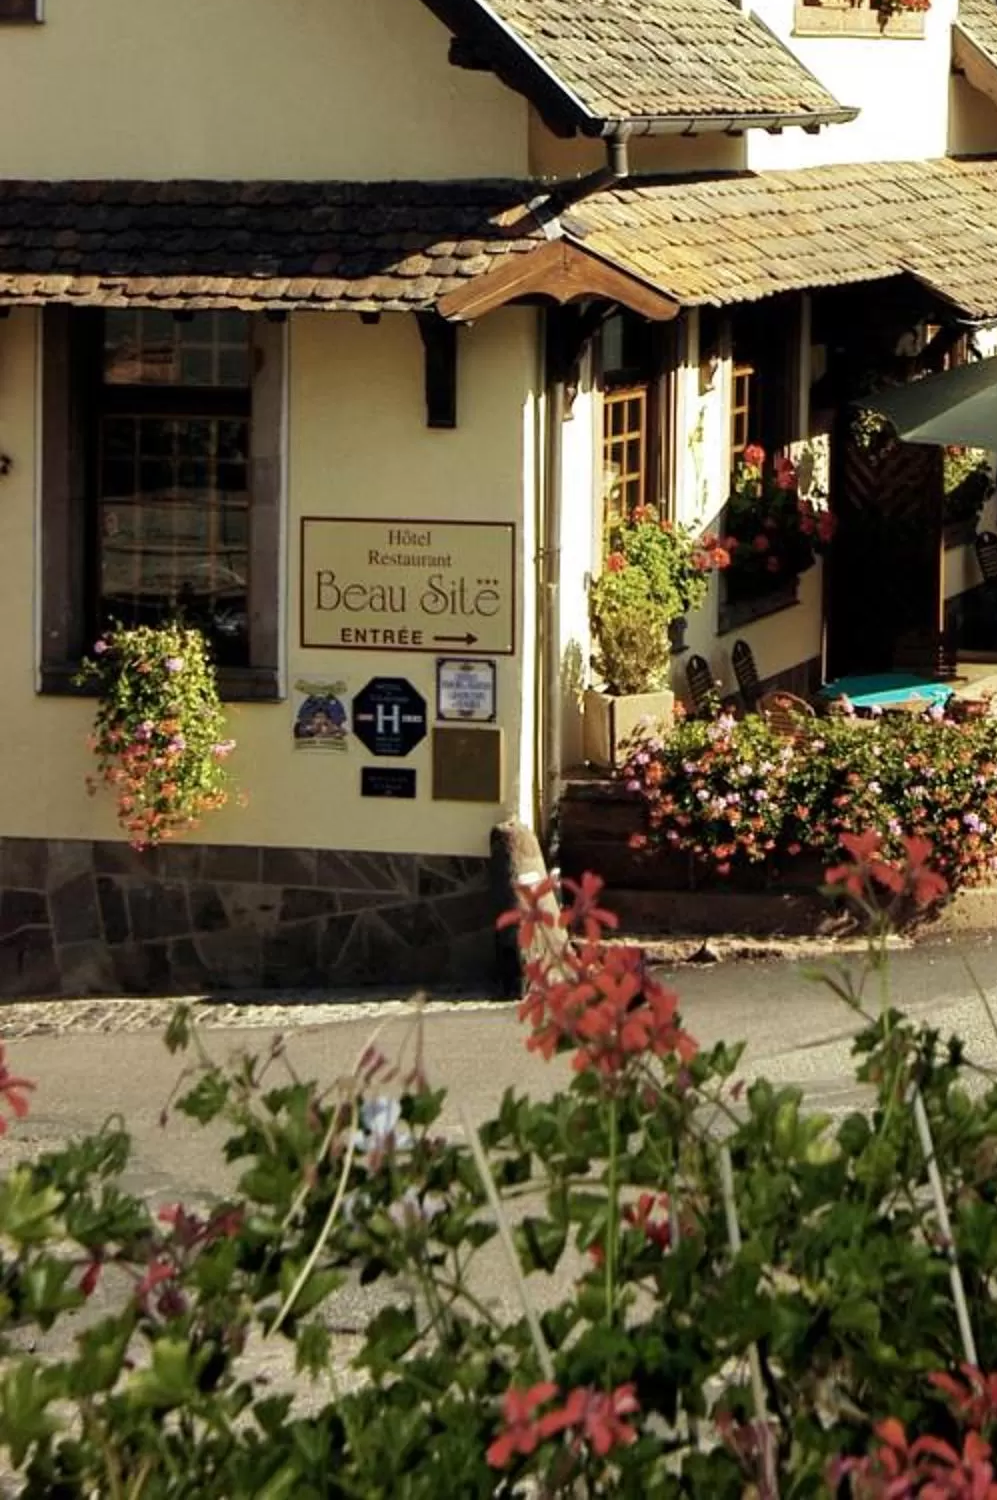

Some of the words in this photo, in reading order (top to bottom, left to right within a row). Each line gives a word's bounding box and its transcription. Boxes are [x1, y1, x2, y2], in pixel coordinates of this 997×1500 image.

[388, 530, 432, 547] Hôtel
[367, 550, 452, 568] Restaurant
[315, 569, 406, 613] Beau
[341, 624, 424, 645] ENTRÉE
[376, 703, 400, 734] H
